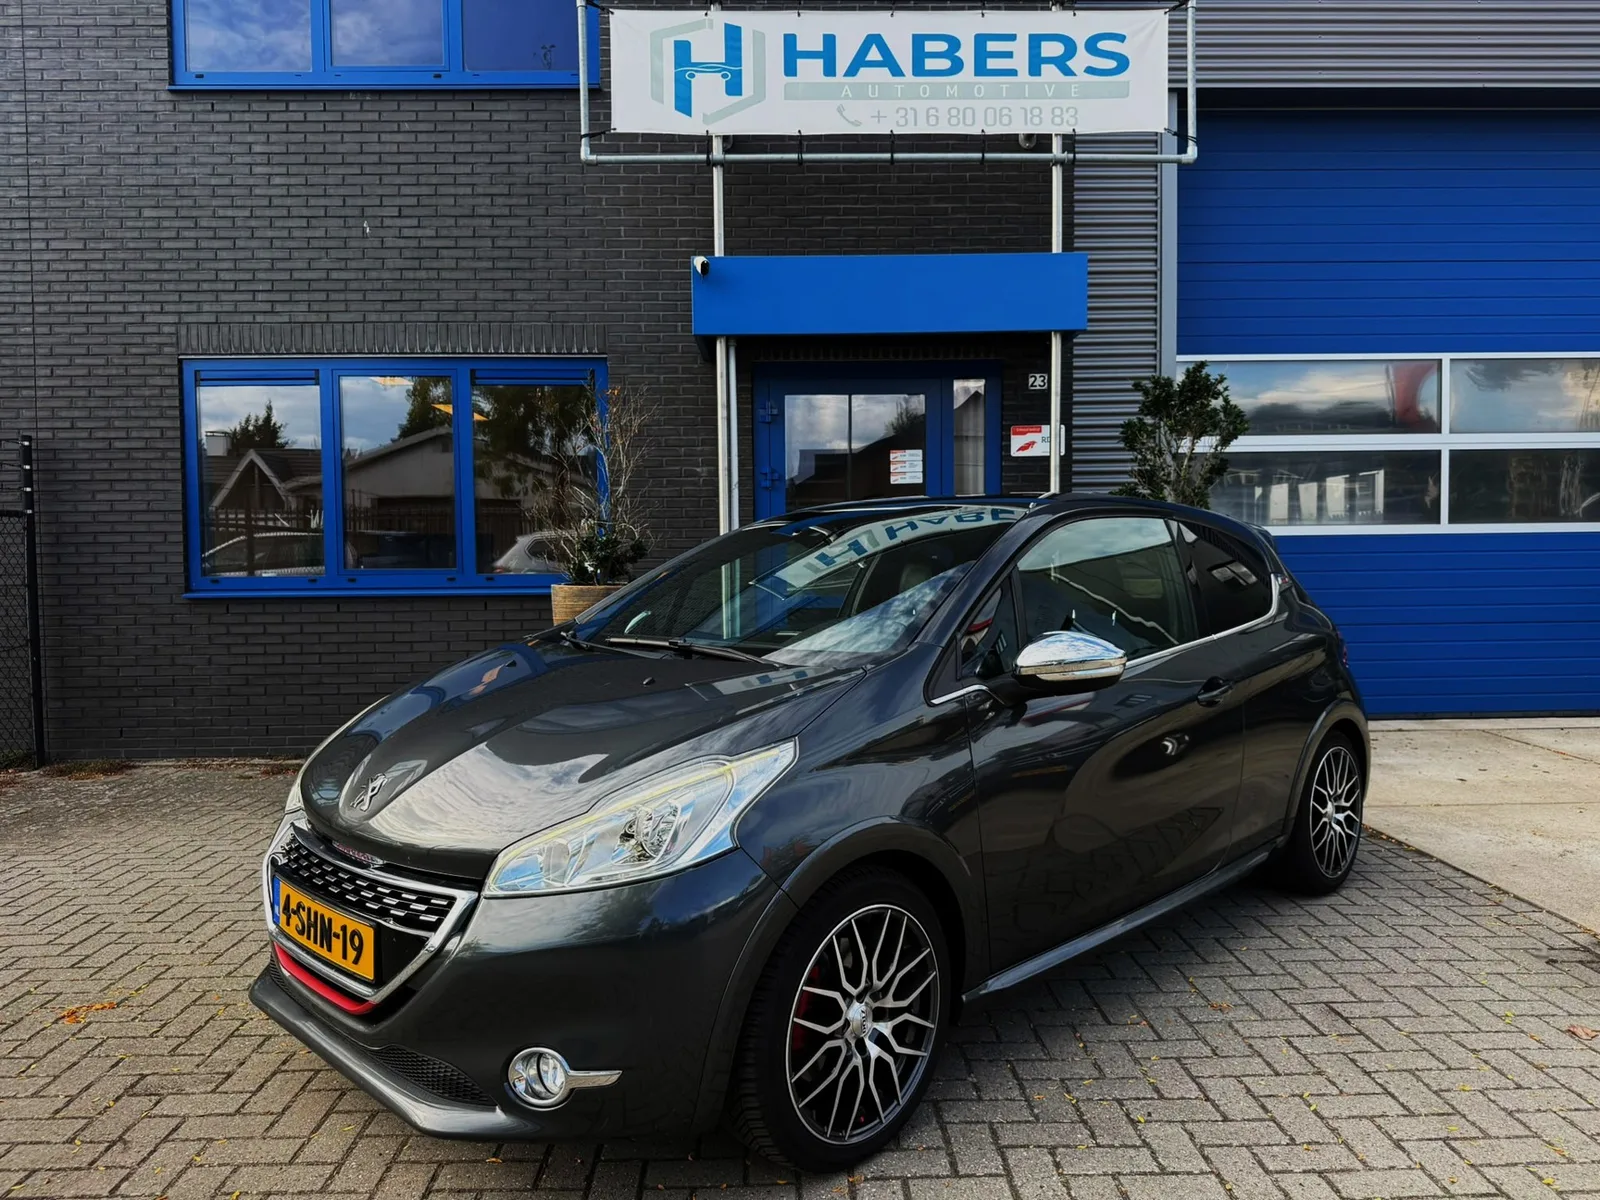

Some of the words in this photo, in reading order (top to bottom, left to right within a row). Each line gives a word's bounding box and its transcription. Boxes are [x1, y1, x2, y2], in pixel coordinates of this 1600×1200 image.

[783, 32, 1130, 77] HABERS
[841, 84, 1080, 98] AUTOMOTIVE
[925, 107, 939, 127] 6
[947, 107, 976, 127] 80
[983, 106, 1012, 127] 06
[1020, 106, 1043, 127] 18
[1050, 106, 1079, 127] 83
[1029, 375, 1046, 388] 23
[282, 894, 364, 965] 4-SHN-19
